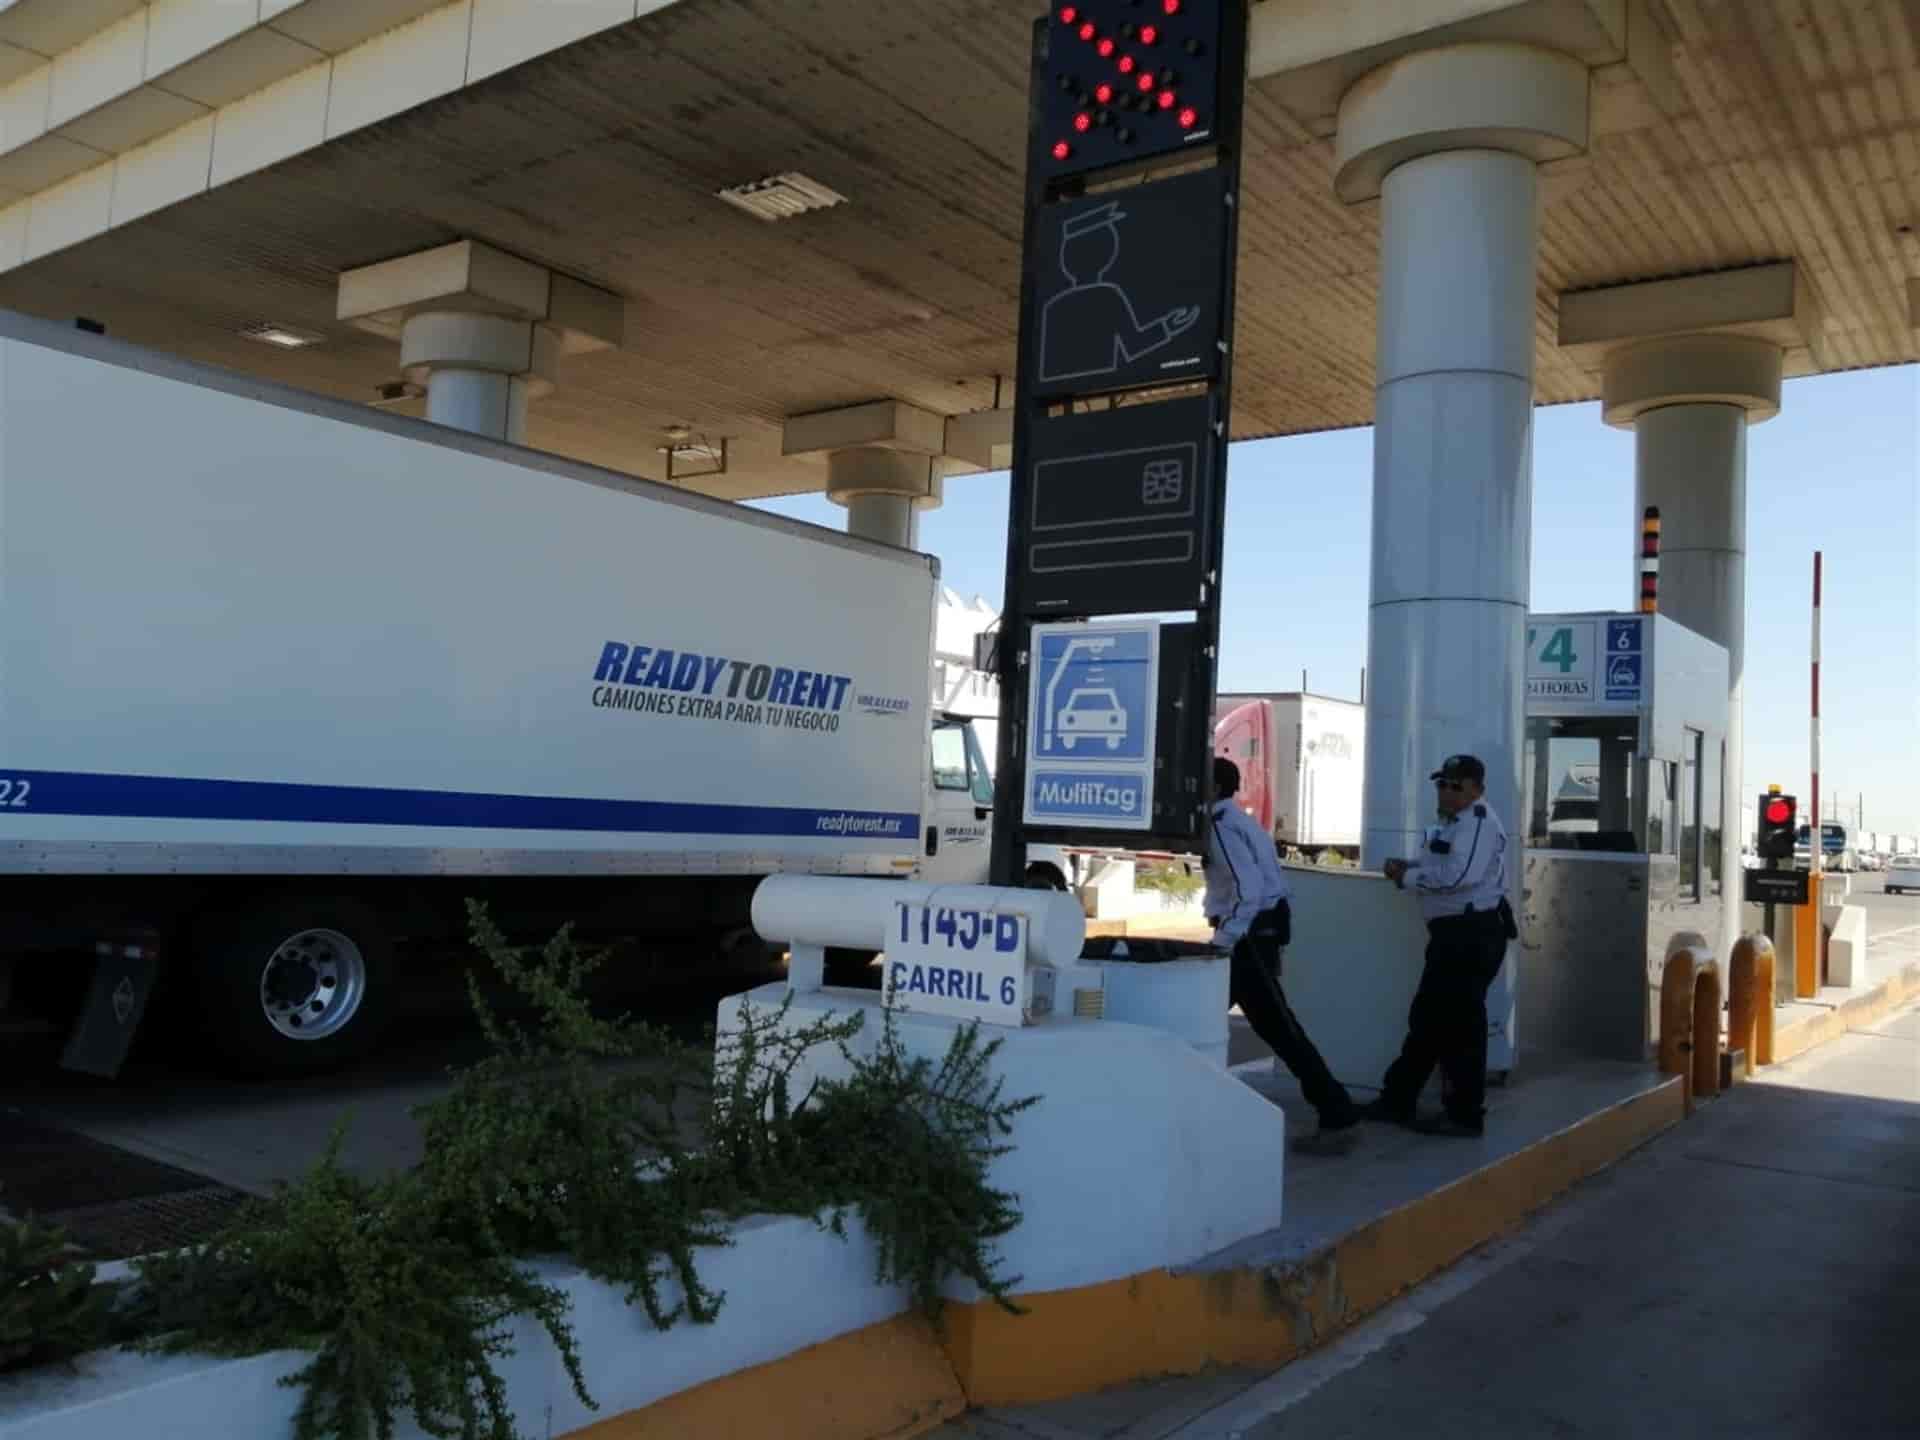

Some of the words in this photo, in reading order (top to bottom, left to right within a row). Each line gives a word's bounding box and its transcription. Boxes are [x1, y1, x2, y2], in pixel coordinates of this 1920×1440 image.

[1617, 631, 1630, 648] 6
[1541, 680, 1588, 695] HORAS
[592, 685, 674, 715] CAMIONES
[678, 699, 722, 721] EXTRA
[725, 703, 762, 726] PARA
[766, 708, 783, 727] TU
[784, 709, 840, 733] NEGOCIO
[0, 779, 31, 806] 22
[1039, 781, 1137, 812] MultiTag
[816, 813, 902, 835] readytorent.mx
[891, 961, 990, 1002] CARRIL
[999, 976, 1017, 1006] 6
